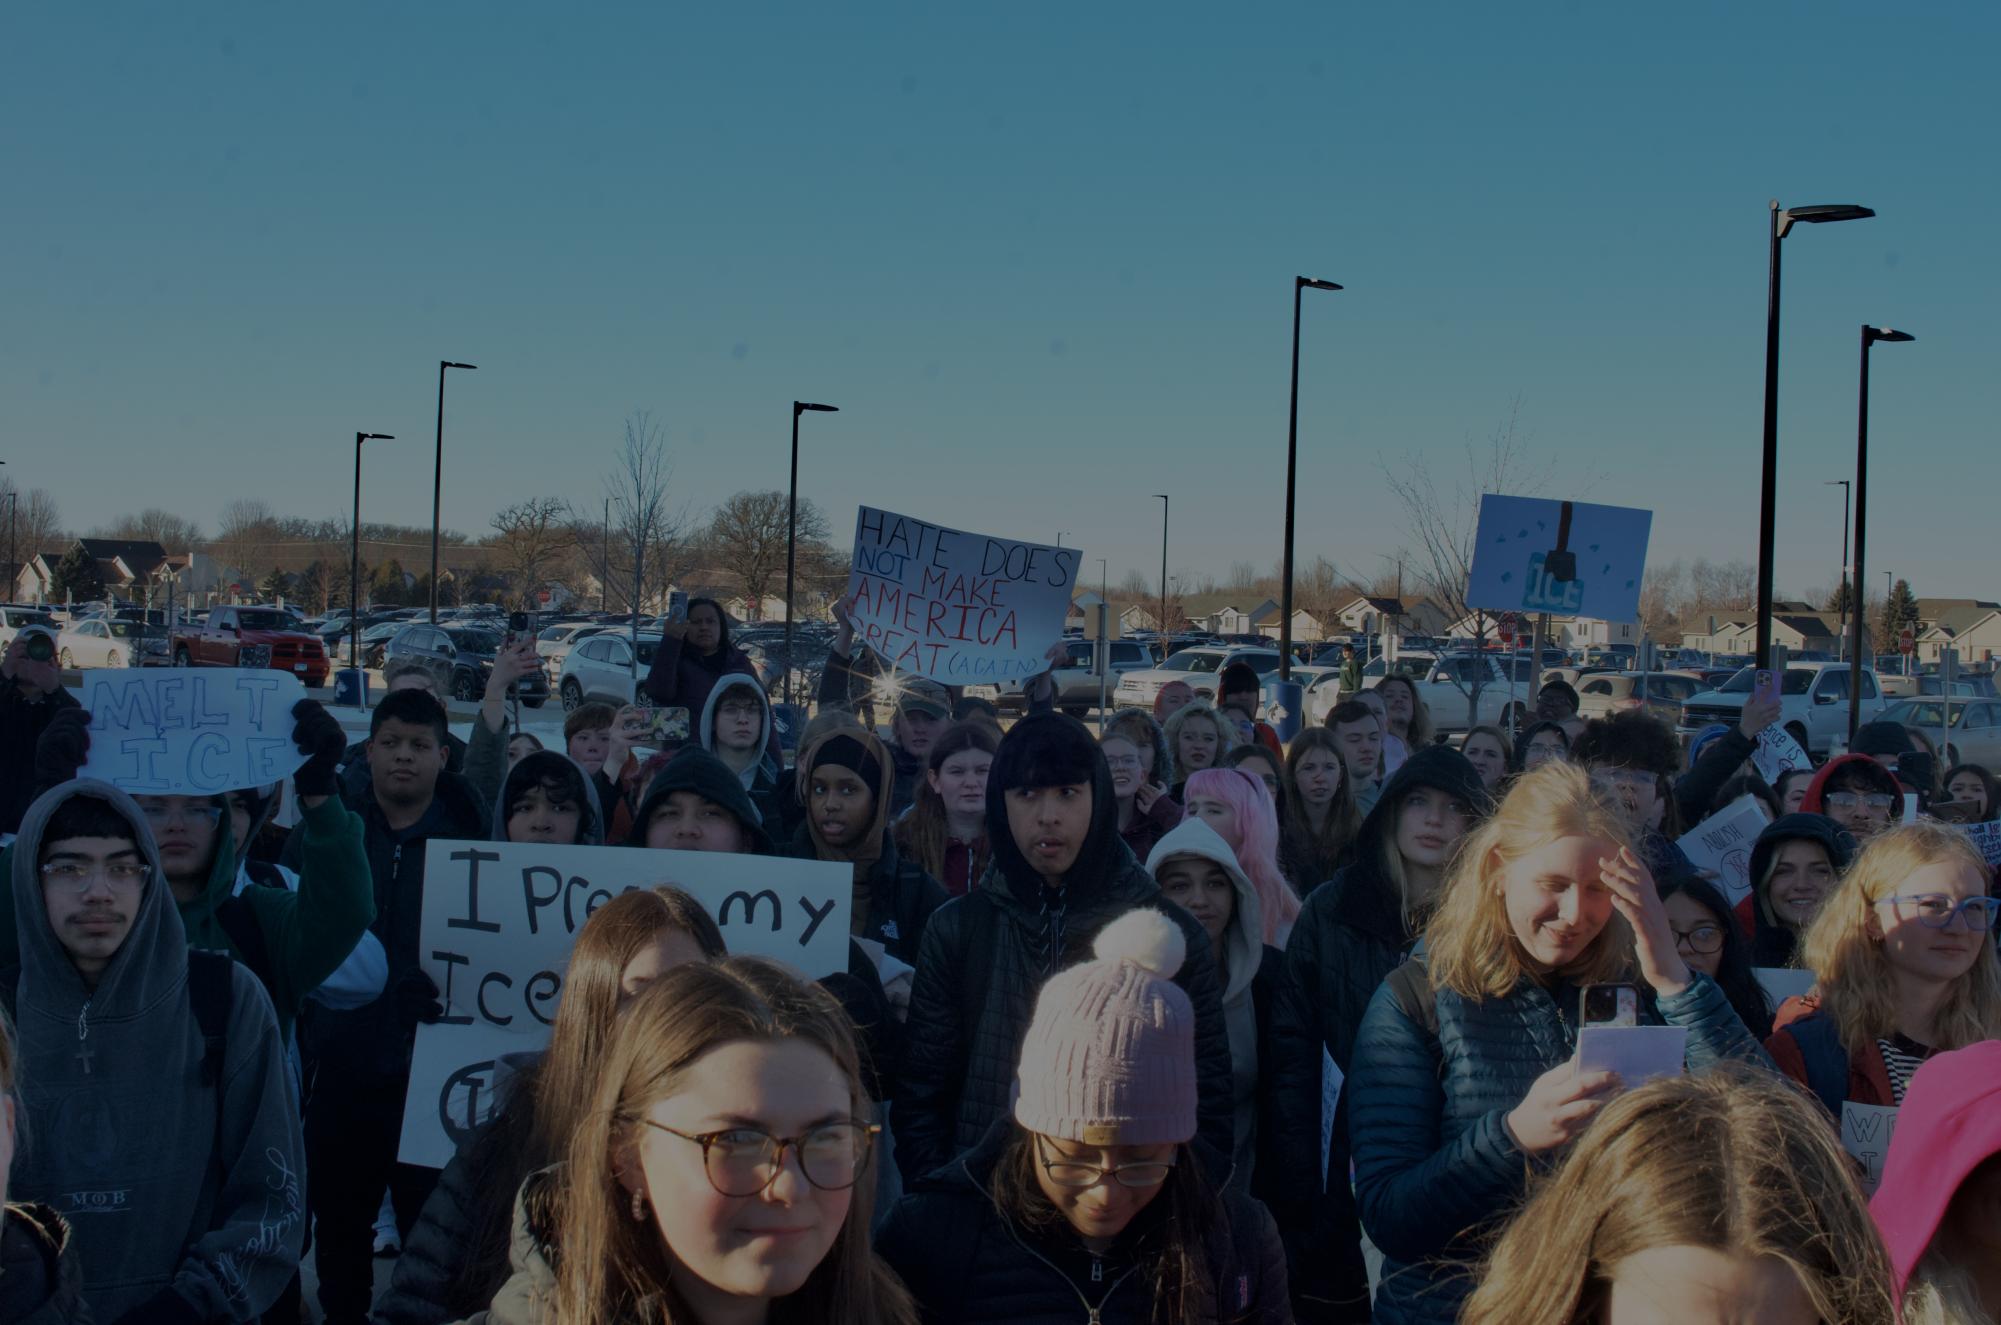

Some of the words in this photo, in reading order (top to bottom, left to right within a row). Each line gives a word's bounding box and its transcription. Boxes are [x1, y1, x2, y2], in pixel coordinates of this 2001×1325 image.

[858, 547, 911, 581] NOT
[922, 566, 1011, 607] MAKE
[860, 508, 960, 570] HATE
[982, 539, 1072, 587] DOES
[849, 576, 1017, 650] AMERICA
[90, 676, 279, 733] MELT
[1761, 724, 1787, 748] ence
[446, 848, 501, 933] I
[522, 866, 640, 934] Pre
[719, 888, 835, 947] my
